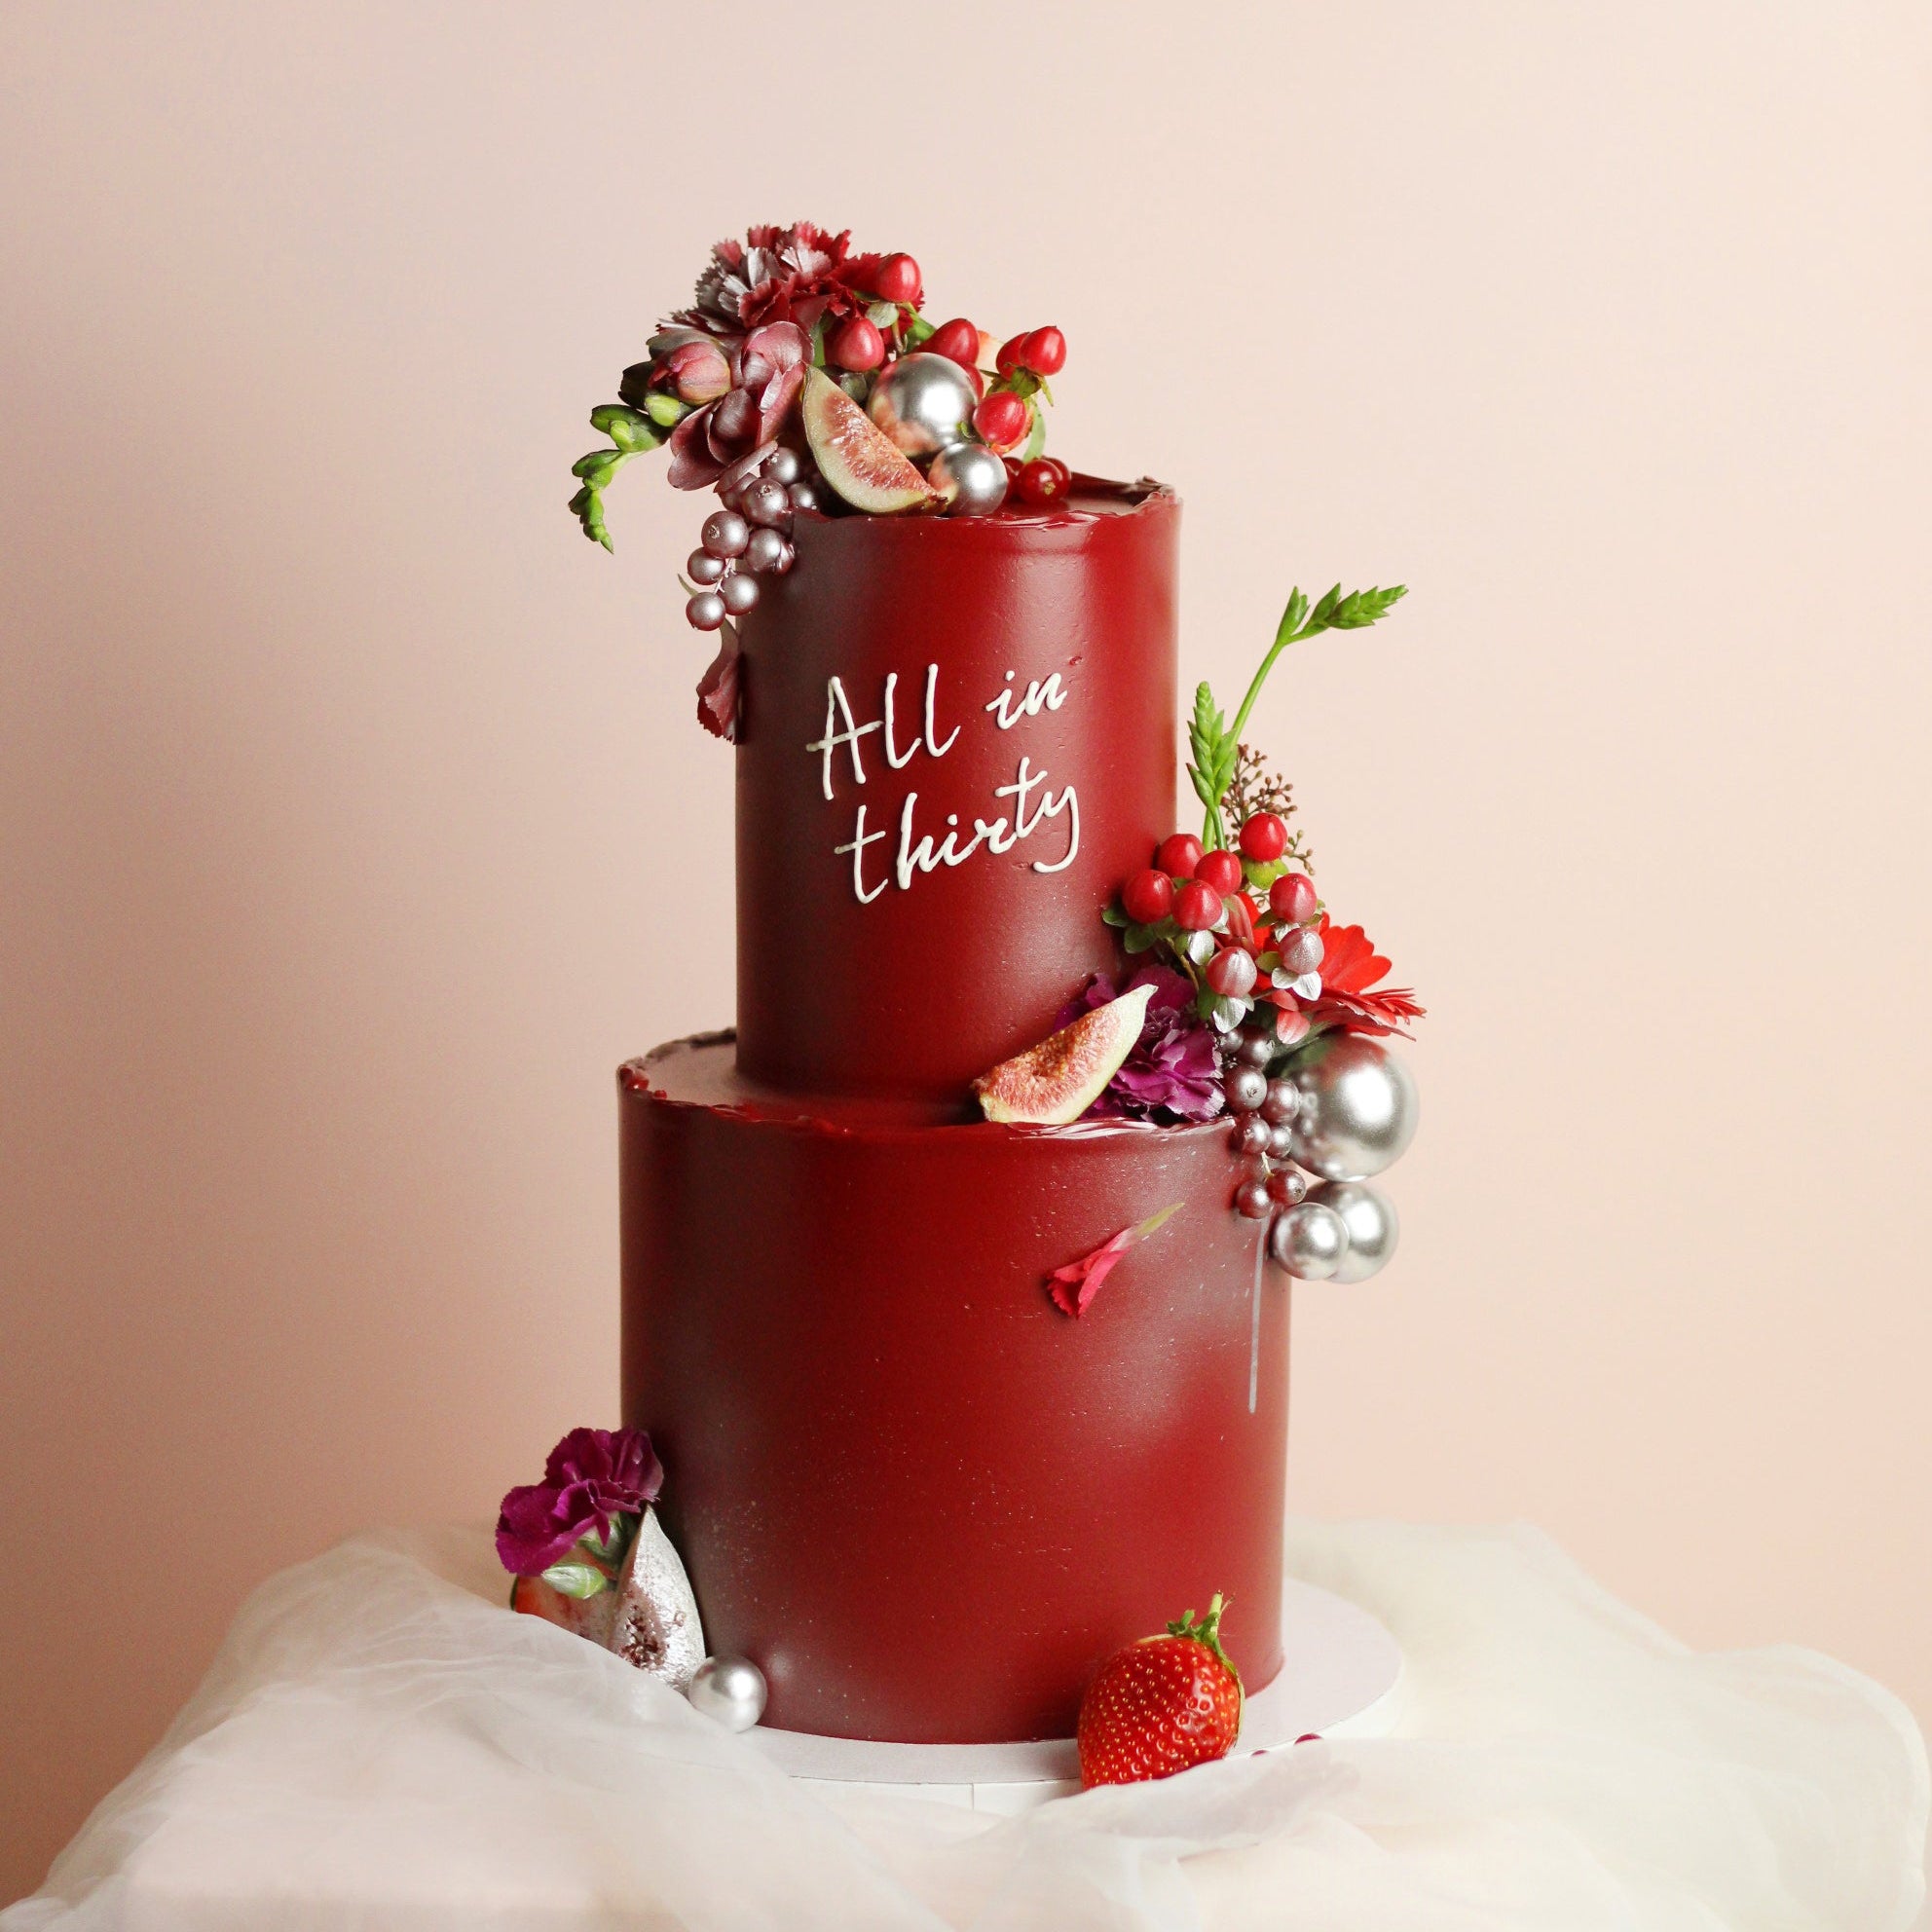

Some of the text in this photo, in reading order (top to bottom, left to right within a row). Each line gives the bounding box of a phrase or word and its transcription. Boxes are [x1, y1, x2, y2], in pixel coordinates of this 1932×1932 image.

[806, 663, 1068, 800] All in
[834, 757, 1080, 904] thirty
